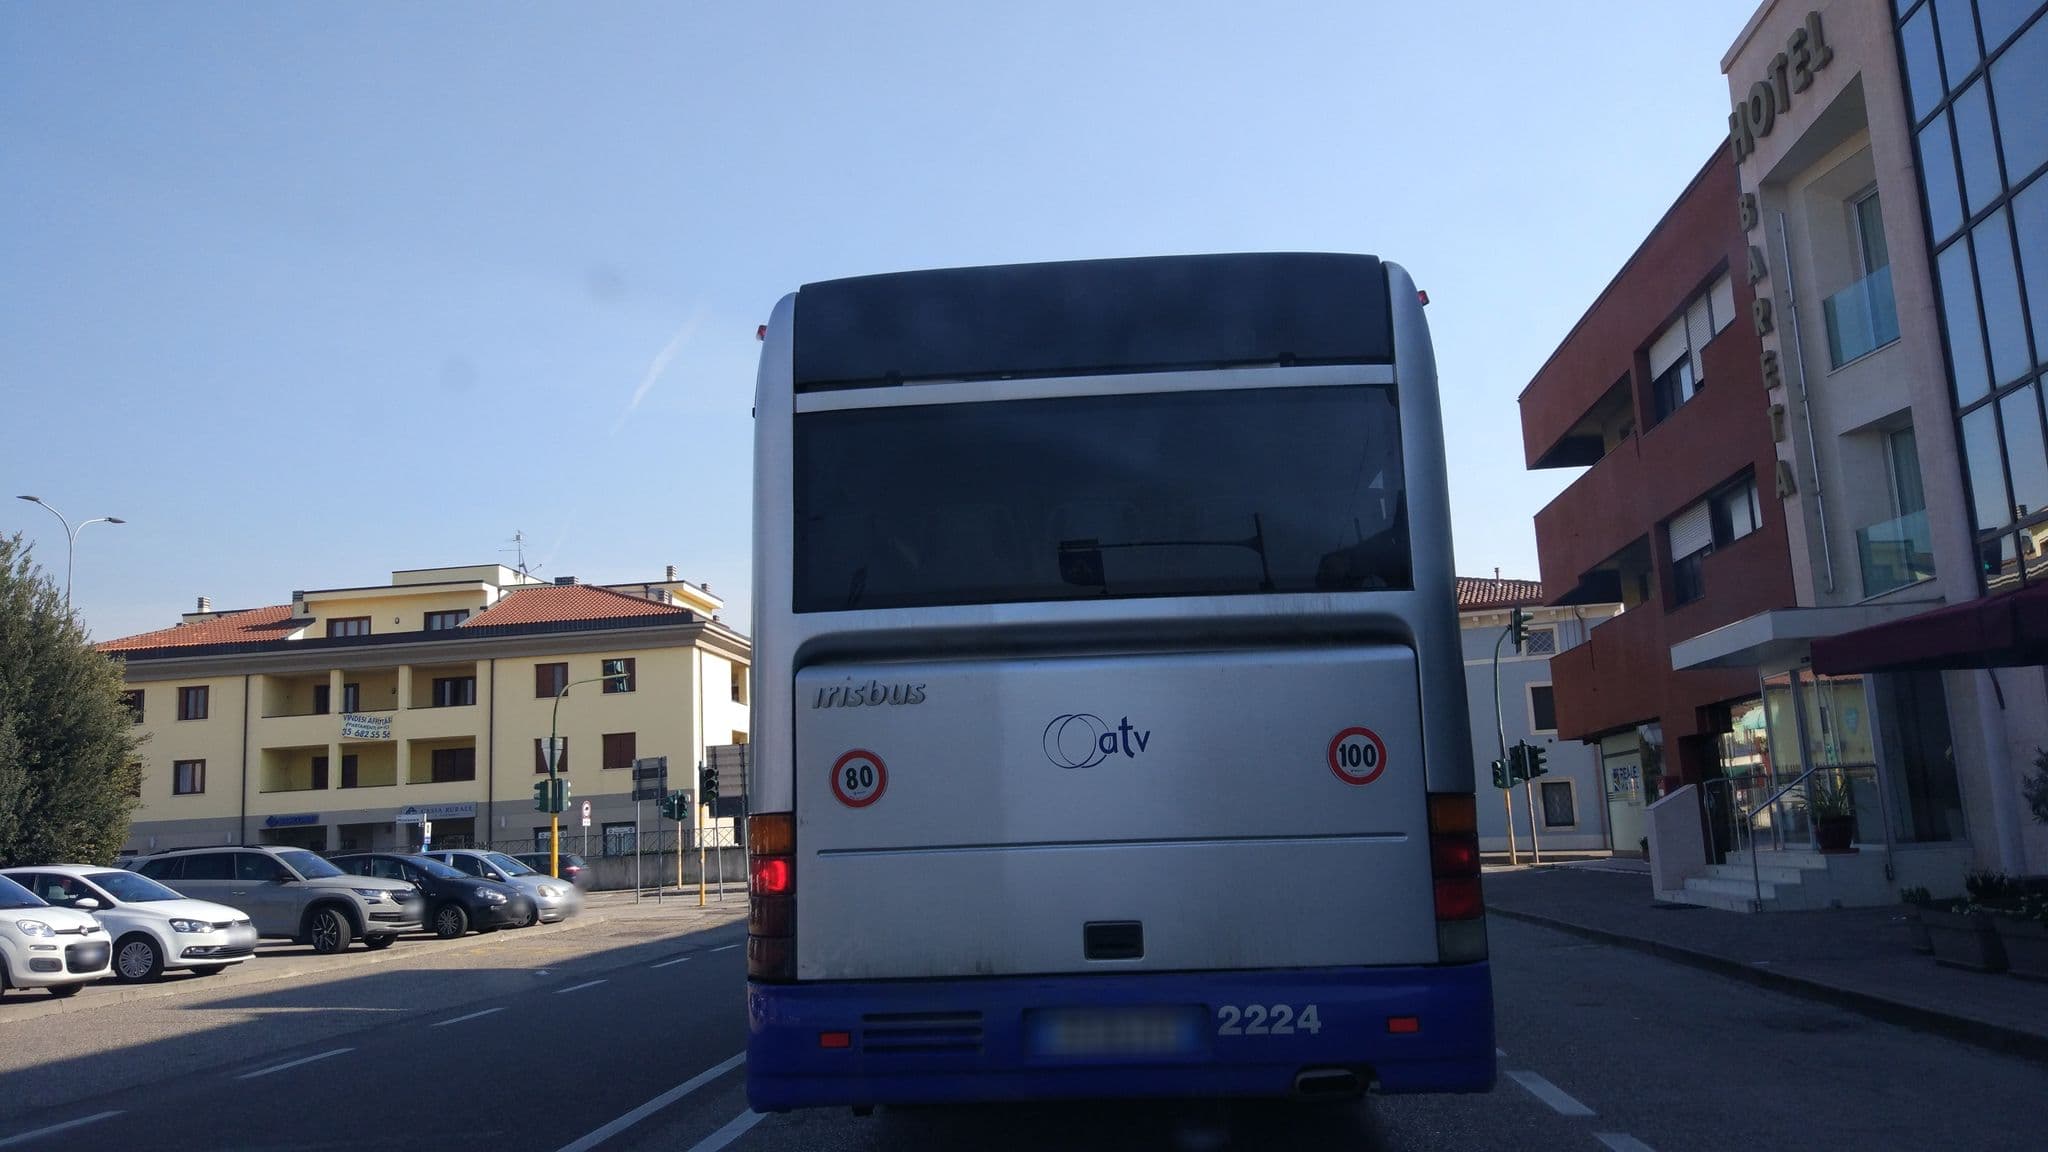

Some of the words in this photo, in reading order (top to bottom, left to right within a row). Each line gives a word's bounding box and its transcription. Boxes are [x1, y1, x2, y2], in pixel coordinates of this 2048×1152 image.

[1728, 11, 1834, 166] HOTEL
[1739, 193, 1797, 500] BARETA
[1099, 716, 1151, 759] atv
[1339, 744, 1376, 767] 100
[845, 765, 873, 790] 80
[1217, 1003, 1322, 1036] 2224
